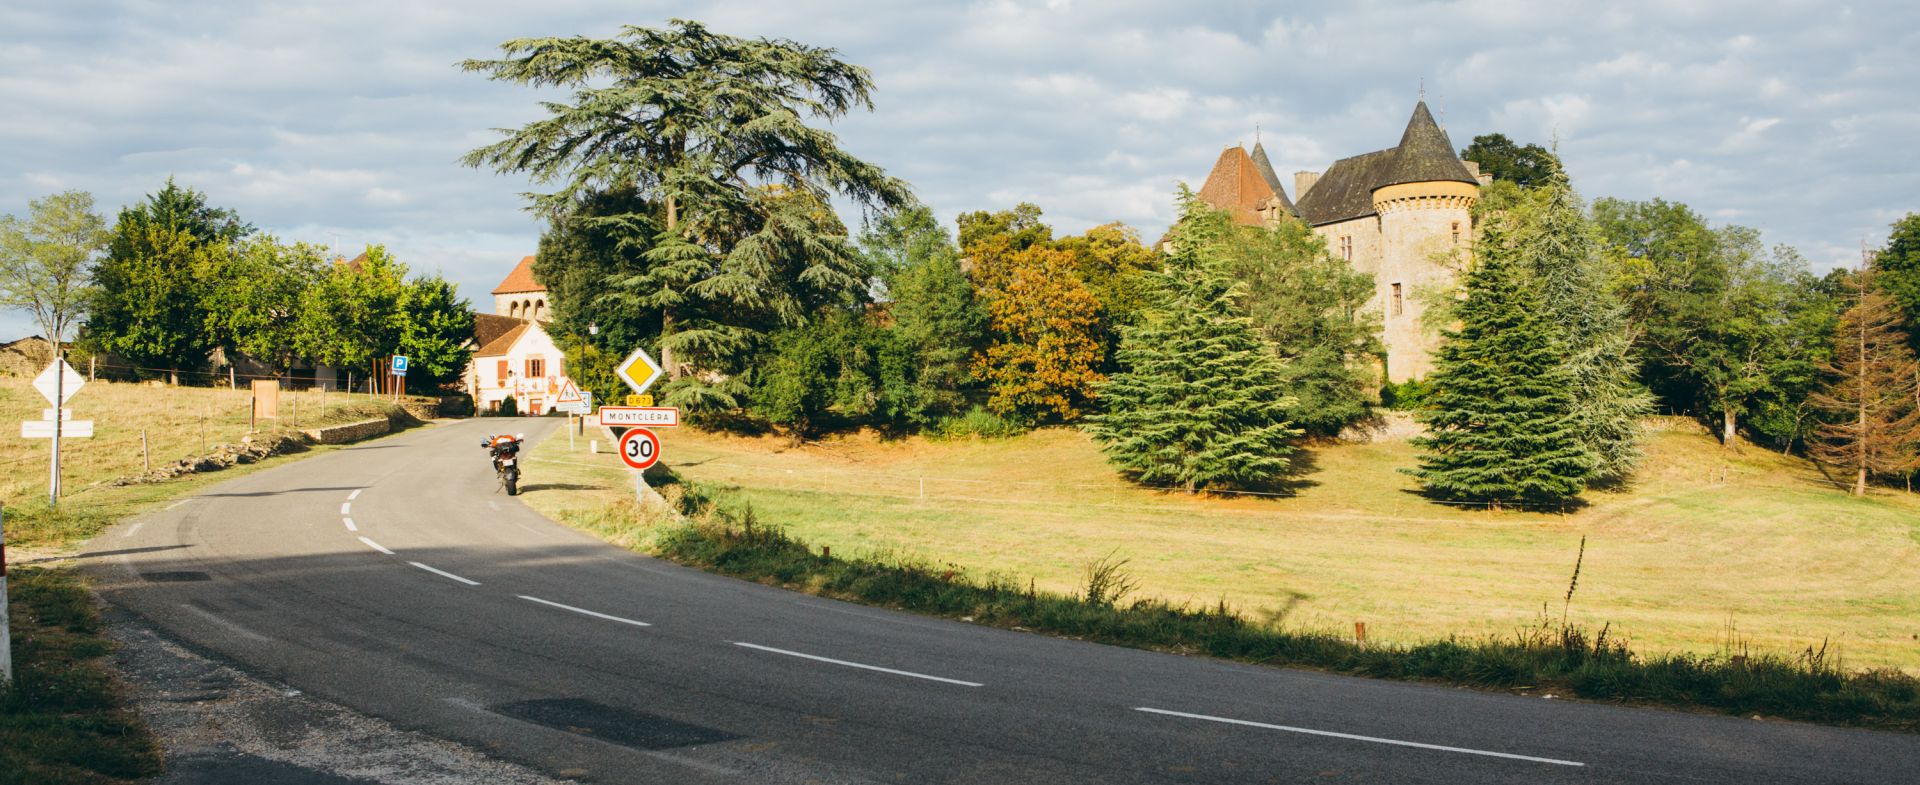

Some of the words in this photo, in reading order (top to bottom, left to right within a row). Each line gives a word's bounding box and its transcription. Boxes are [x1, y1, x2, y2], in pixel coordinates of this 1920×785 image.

[396, 358, 404, 368] P
[609, 412, 669, 421] MONTCLÉRA
[628, 440, 653, 457] 30
